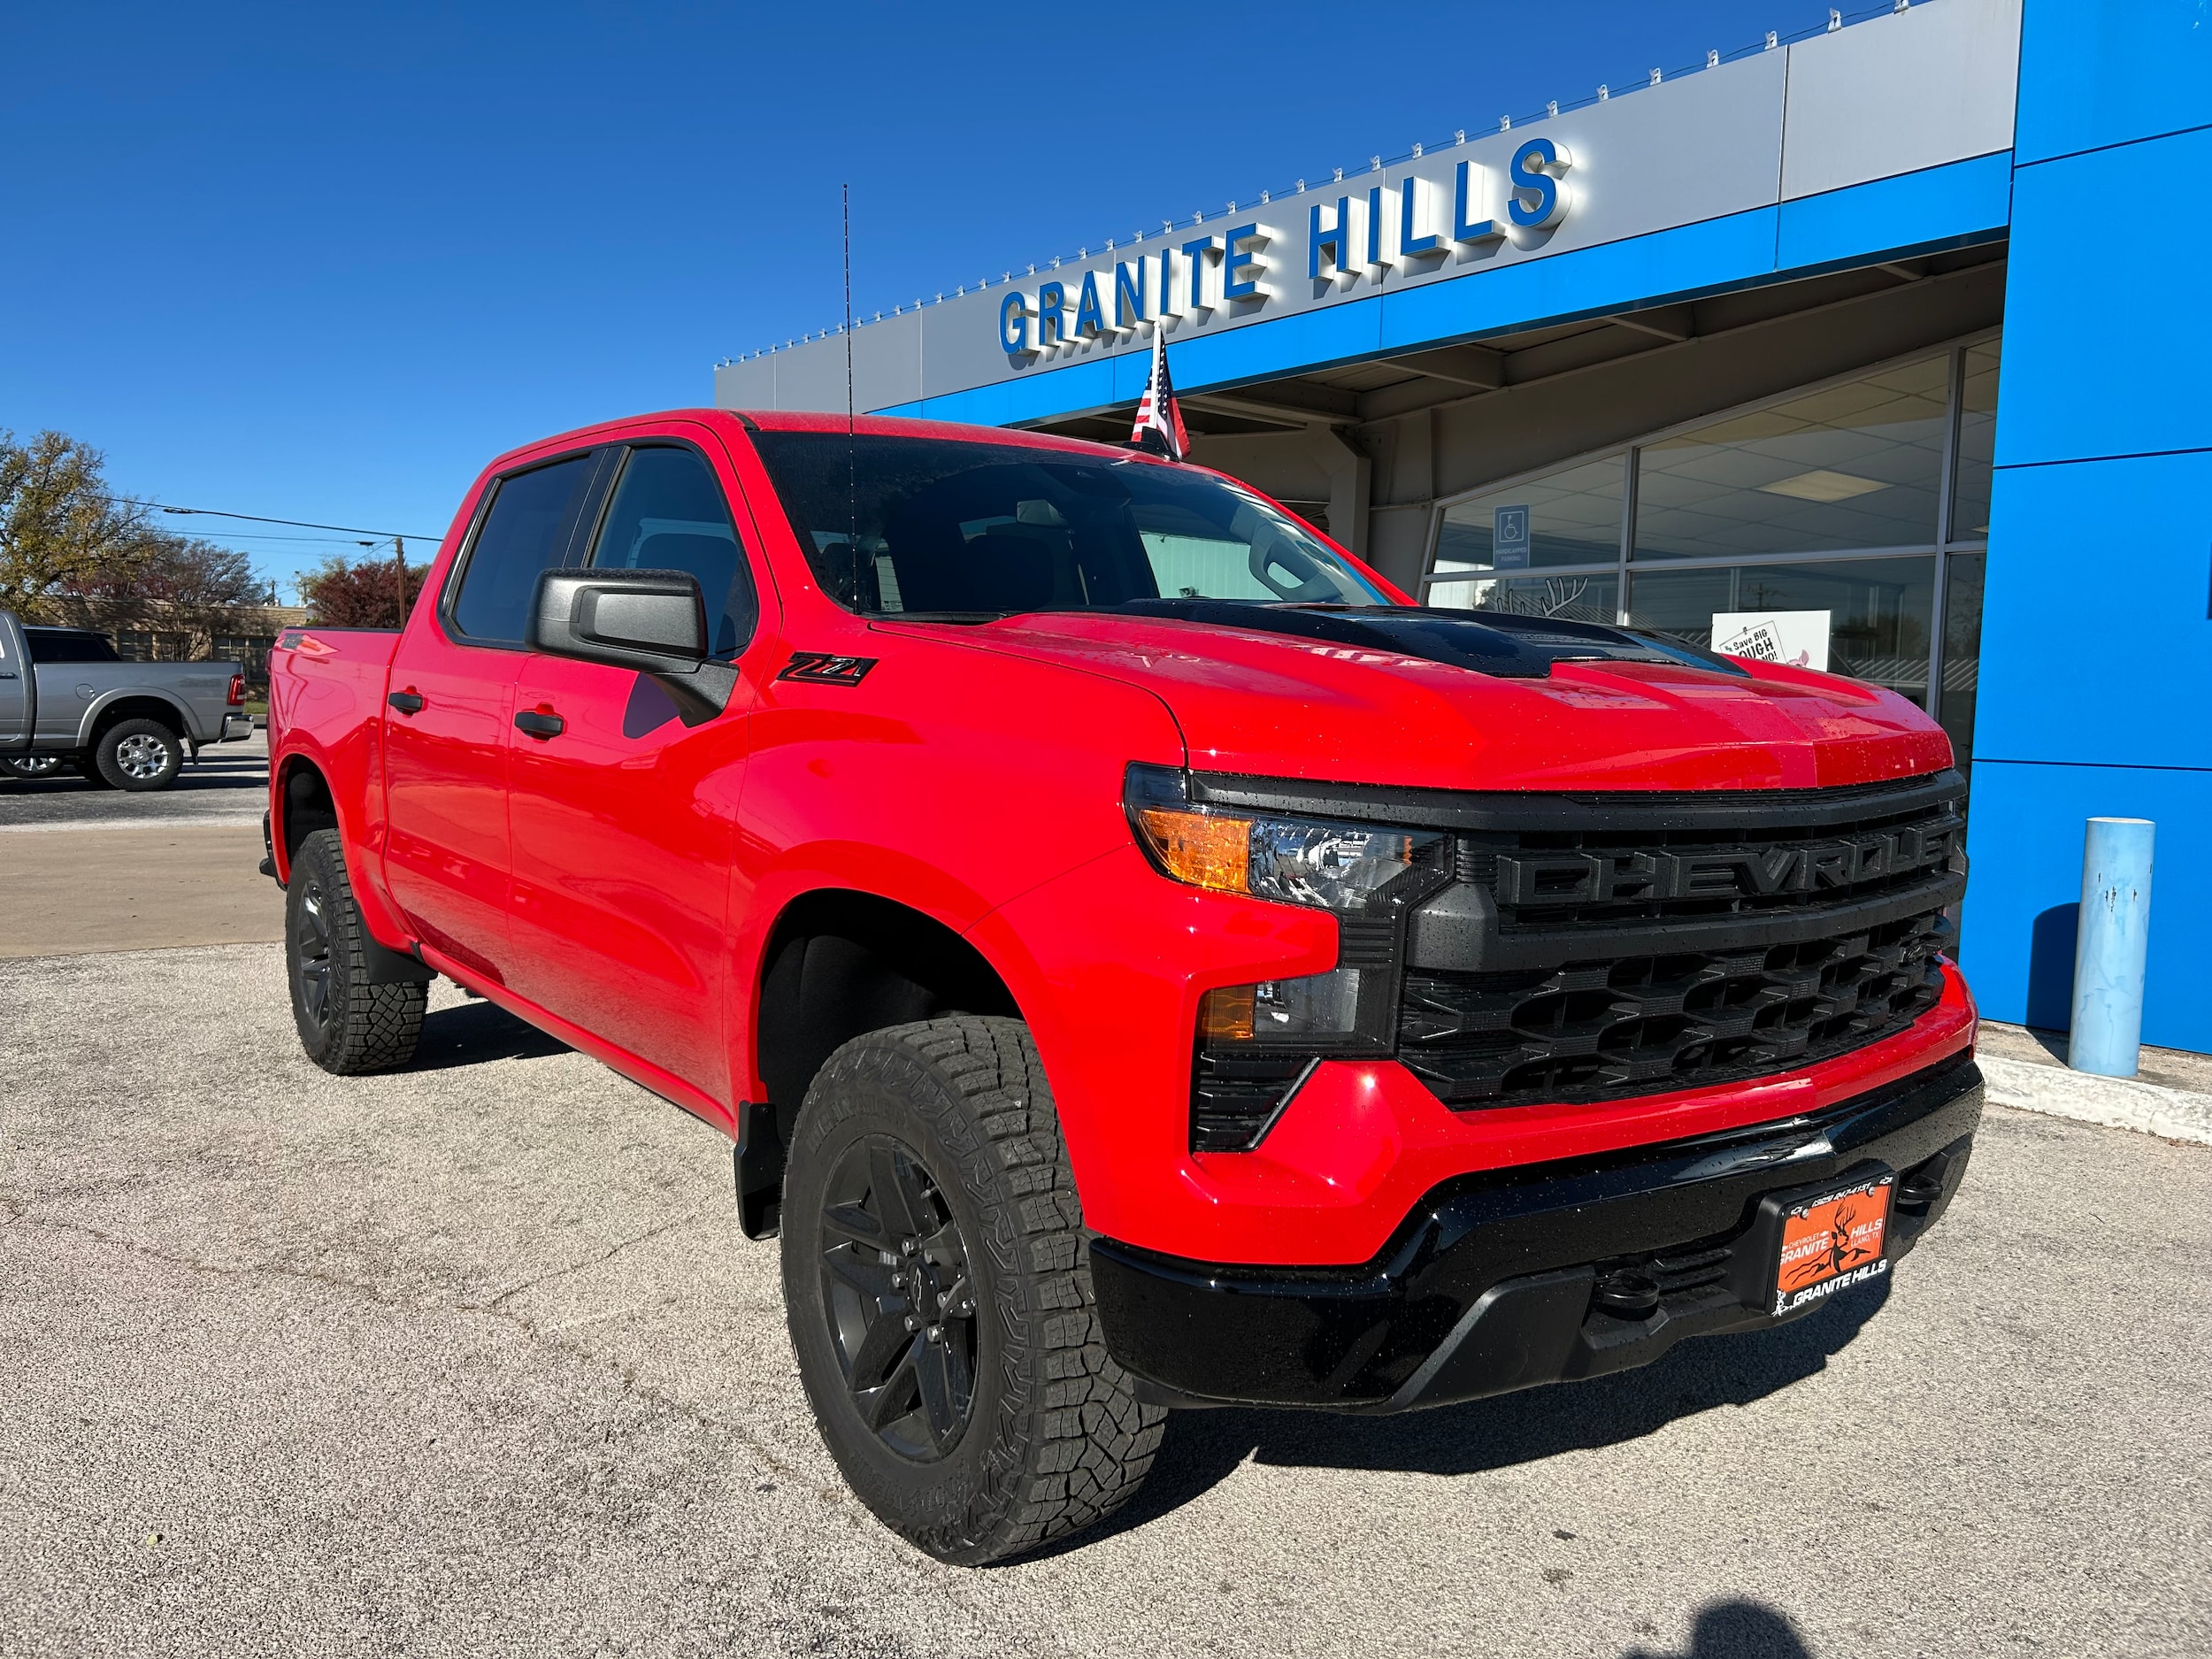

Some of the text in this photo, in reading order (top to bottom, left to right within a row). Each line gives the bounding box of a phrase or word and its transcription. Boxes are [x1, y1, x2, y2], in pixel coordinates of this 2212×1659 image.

[1000, 138, 1572, 356] GRANITE HILLS
[1732, 628, 1768, 650] Save BIG
[777, 650, 880, 687] Z71
[1788, 1232, 1820, 1249] CHEVROLET
[1850, 1217, 1884, 1240] HILLS
[1793, 1259, 1887, 1307] GRANITE HILLS
